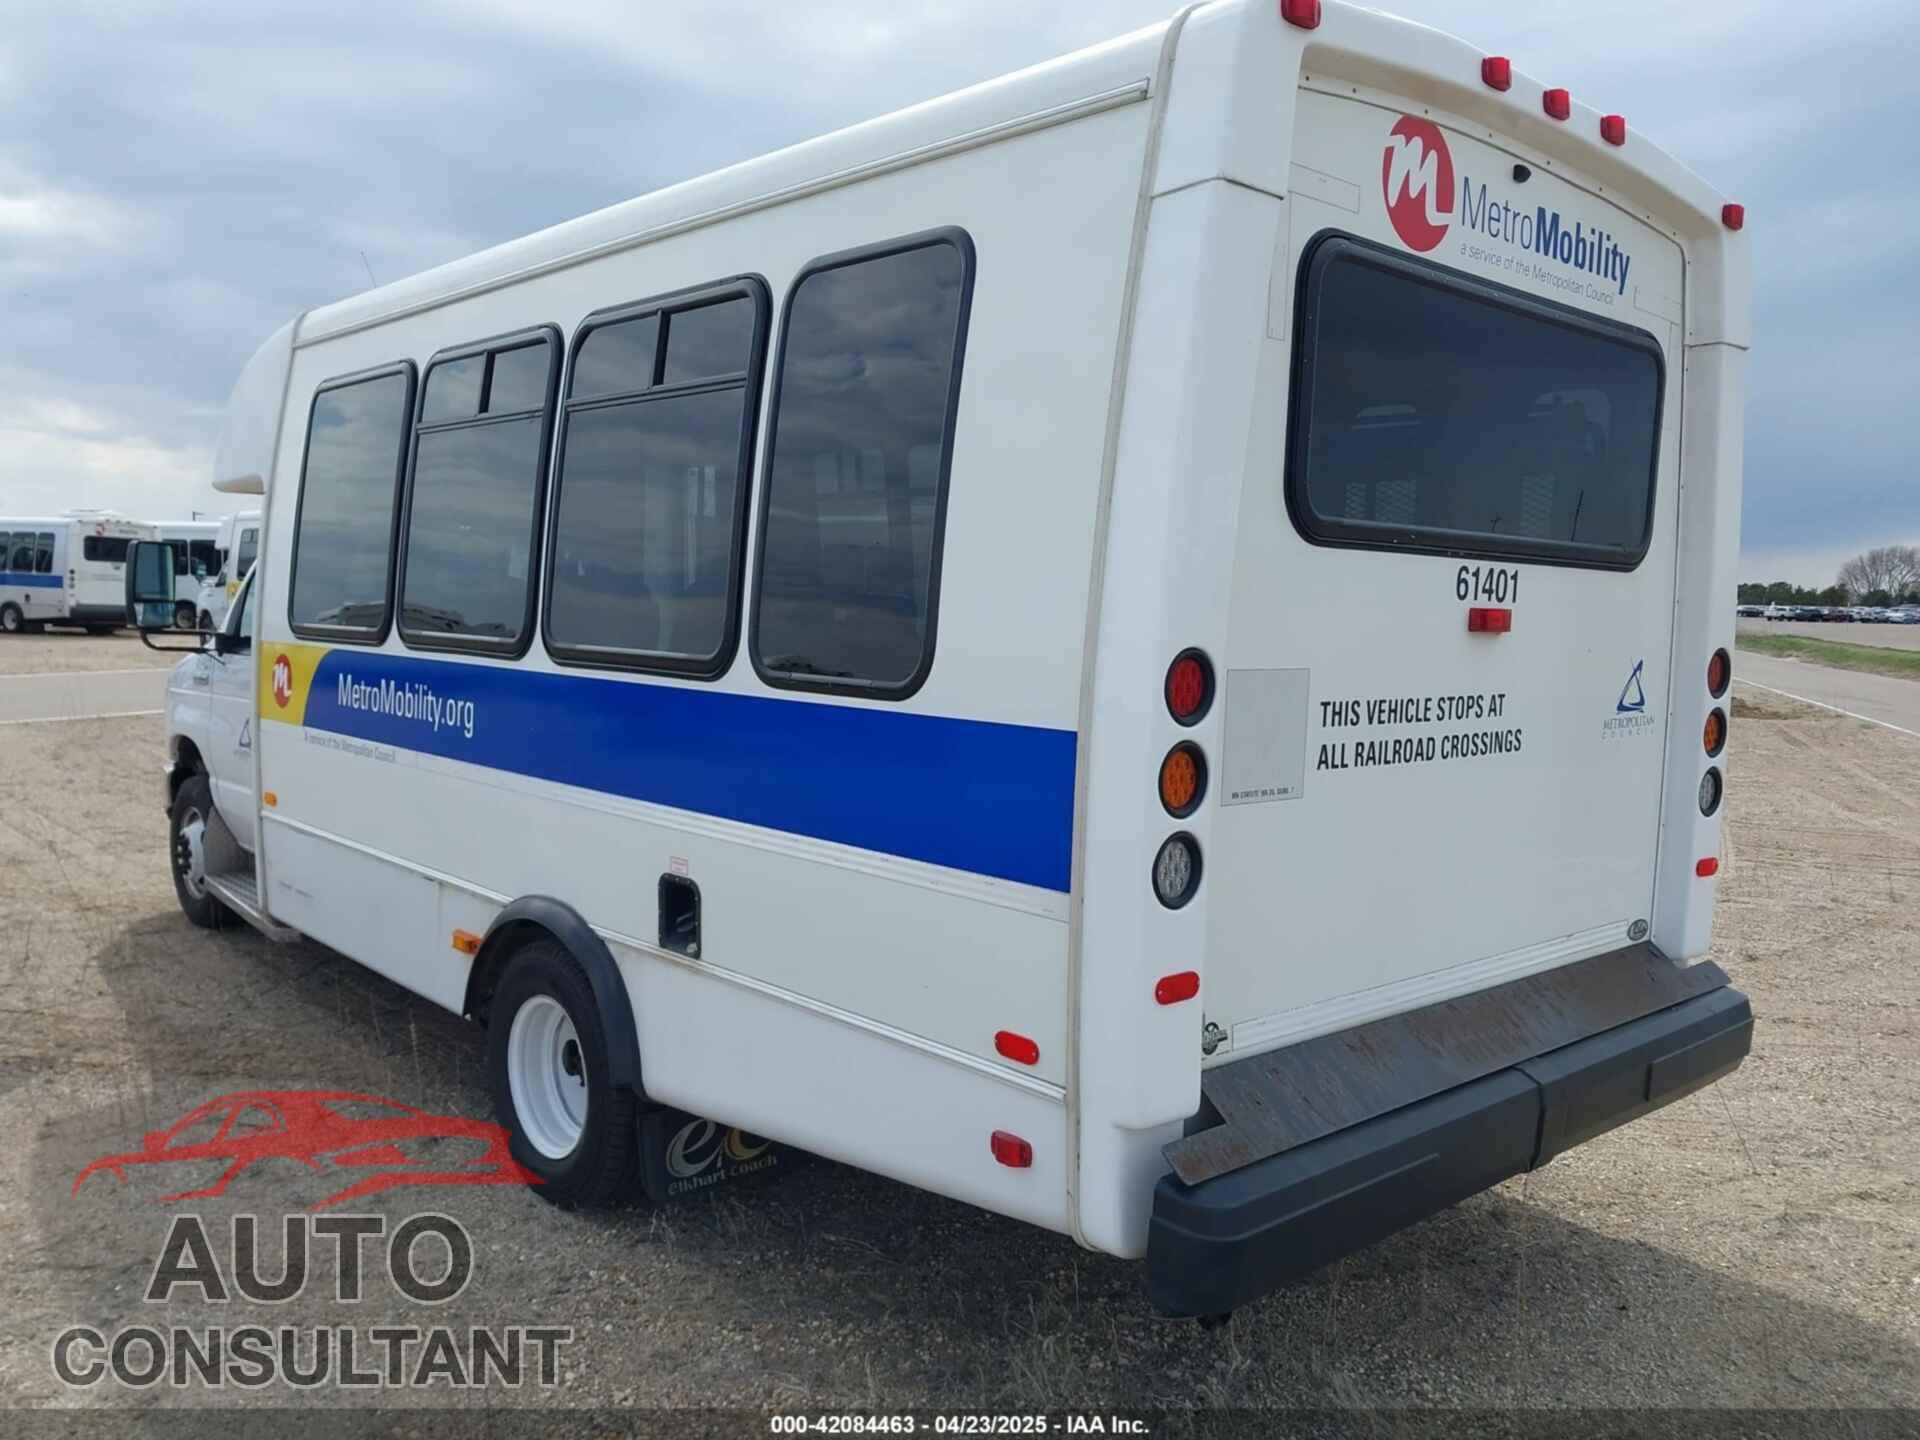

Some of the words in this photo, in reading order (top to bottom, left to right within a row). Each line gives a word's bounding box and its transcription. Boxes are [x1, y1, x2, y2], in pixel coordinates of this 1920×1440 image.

[1461, 176, 1631, 295] MetroMobility
[1468, 246, 1501, 267] service
[1504, 256, 1513, 270] of
[1515, 259, 1531, 277] the
[1532, 263, 1584, 297] Metropolitan
[1456, 565, 1519, 604] 61401
[337, 673, 476, 738] MetroMobility.org
[1320, 700, 1361, 728] THIS
[1366, 697, 1433, 726] VEHICLE
[1436, 694, 1484, 722] STOPS
[1487, 693, 1506, 718] AT
[1316, 743, 1349, 771] ALL
[1354, 737, 1436, 767] RAILROAD
[1440, 728, 1522, 760] CROSSINGS
